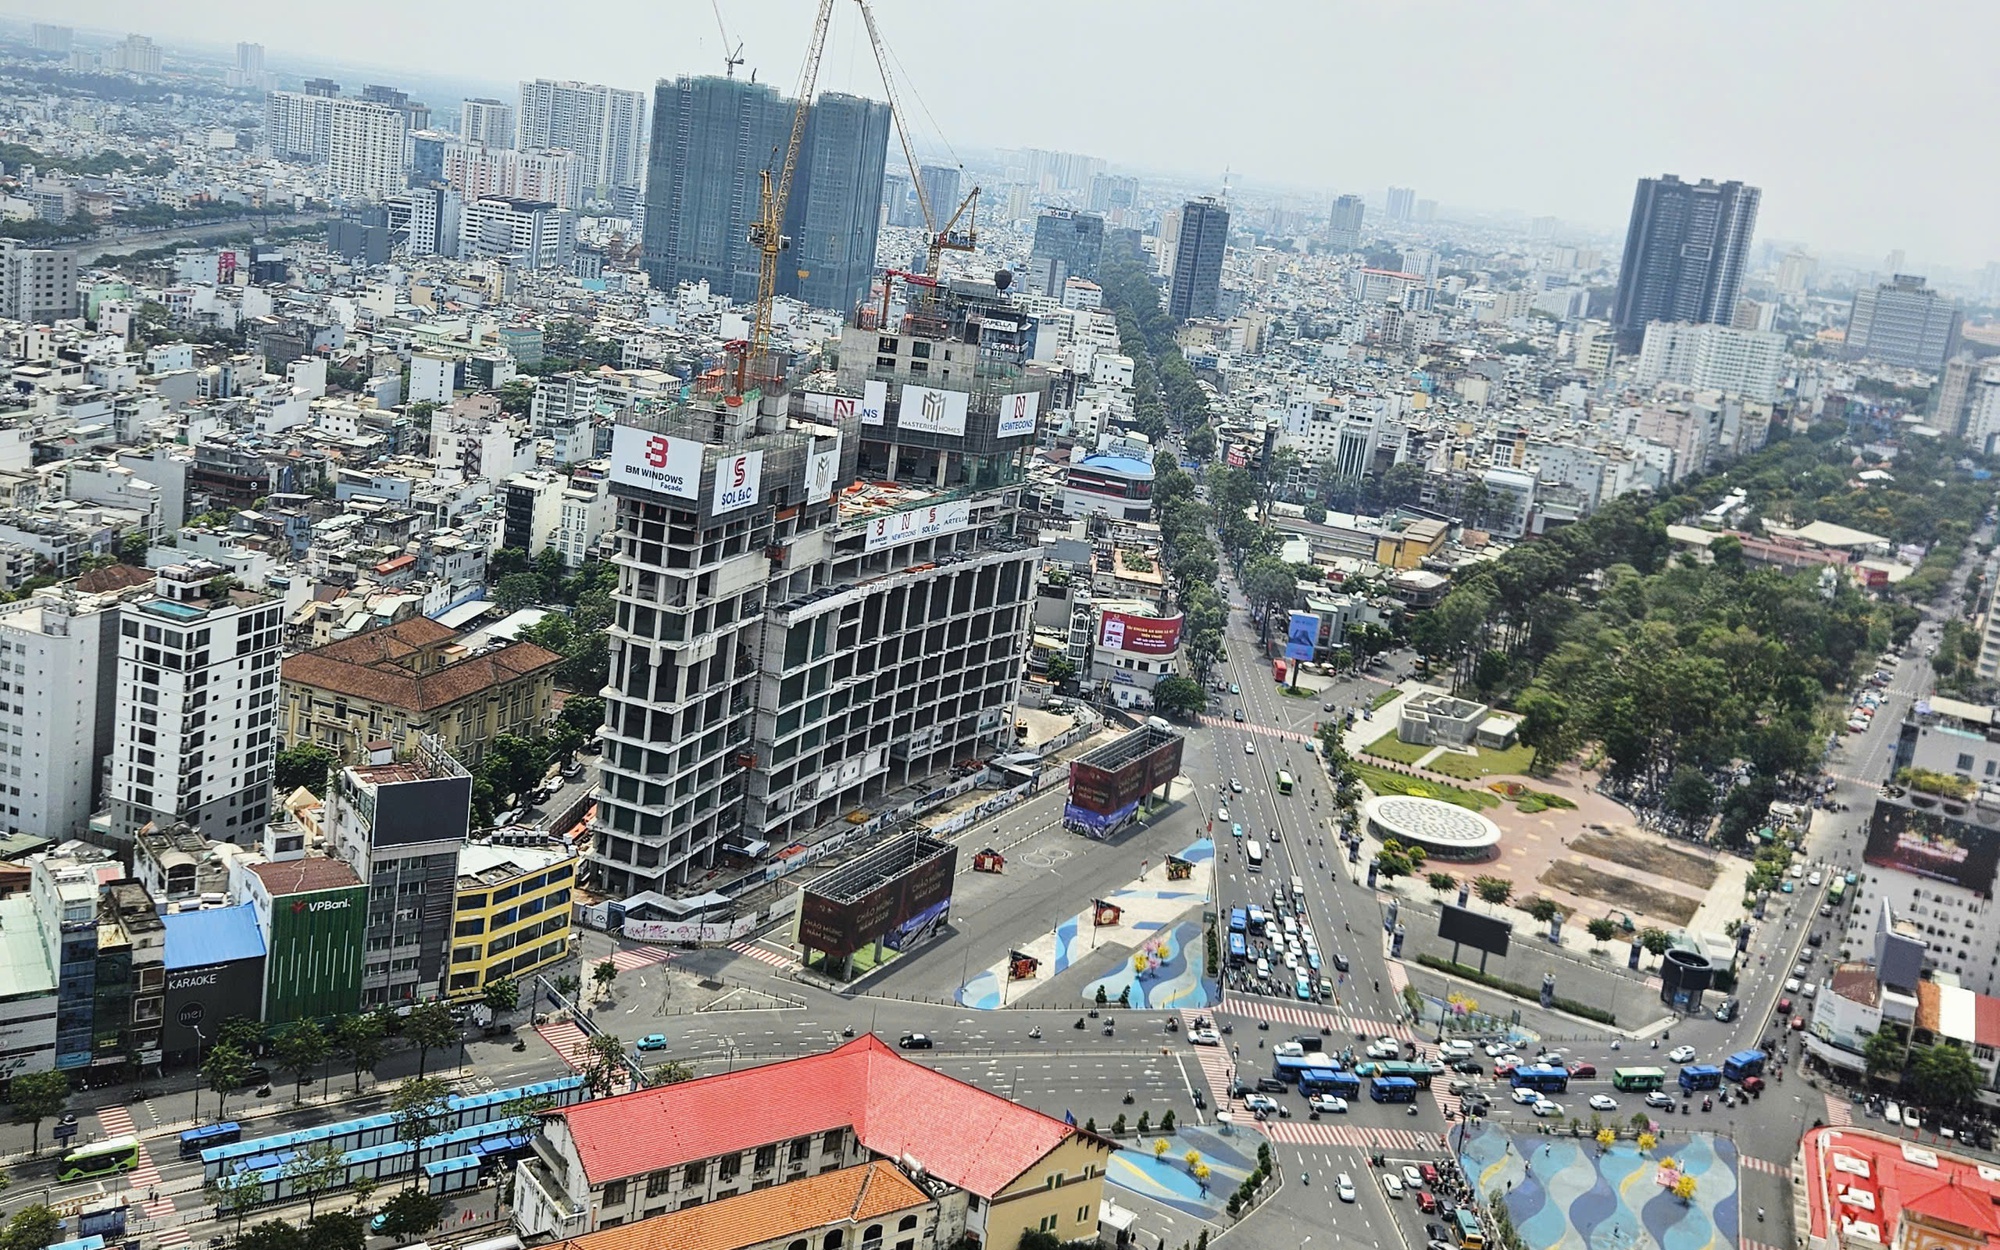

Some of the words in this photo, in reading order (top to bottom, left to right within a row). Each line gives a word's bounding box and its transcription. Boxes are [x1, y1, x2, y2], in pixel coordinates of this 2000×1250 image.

[939, 426, 960, 434] HOMES
[1000, 419, 1033, 431] NEWTECONS
[625, 465, 640, 475] BM
[641, 468, 684, 485] WINDOWS
[660, 482, 682, 492] Façade
[721, 491, 736, 506] SOL
[943, 516, 968, 525] ARTELIA
[309, 898, 352, 912] VPBank
[168, 973, 218, 990] KARAOKE
